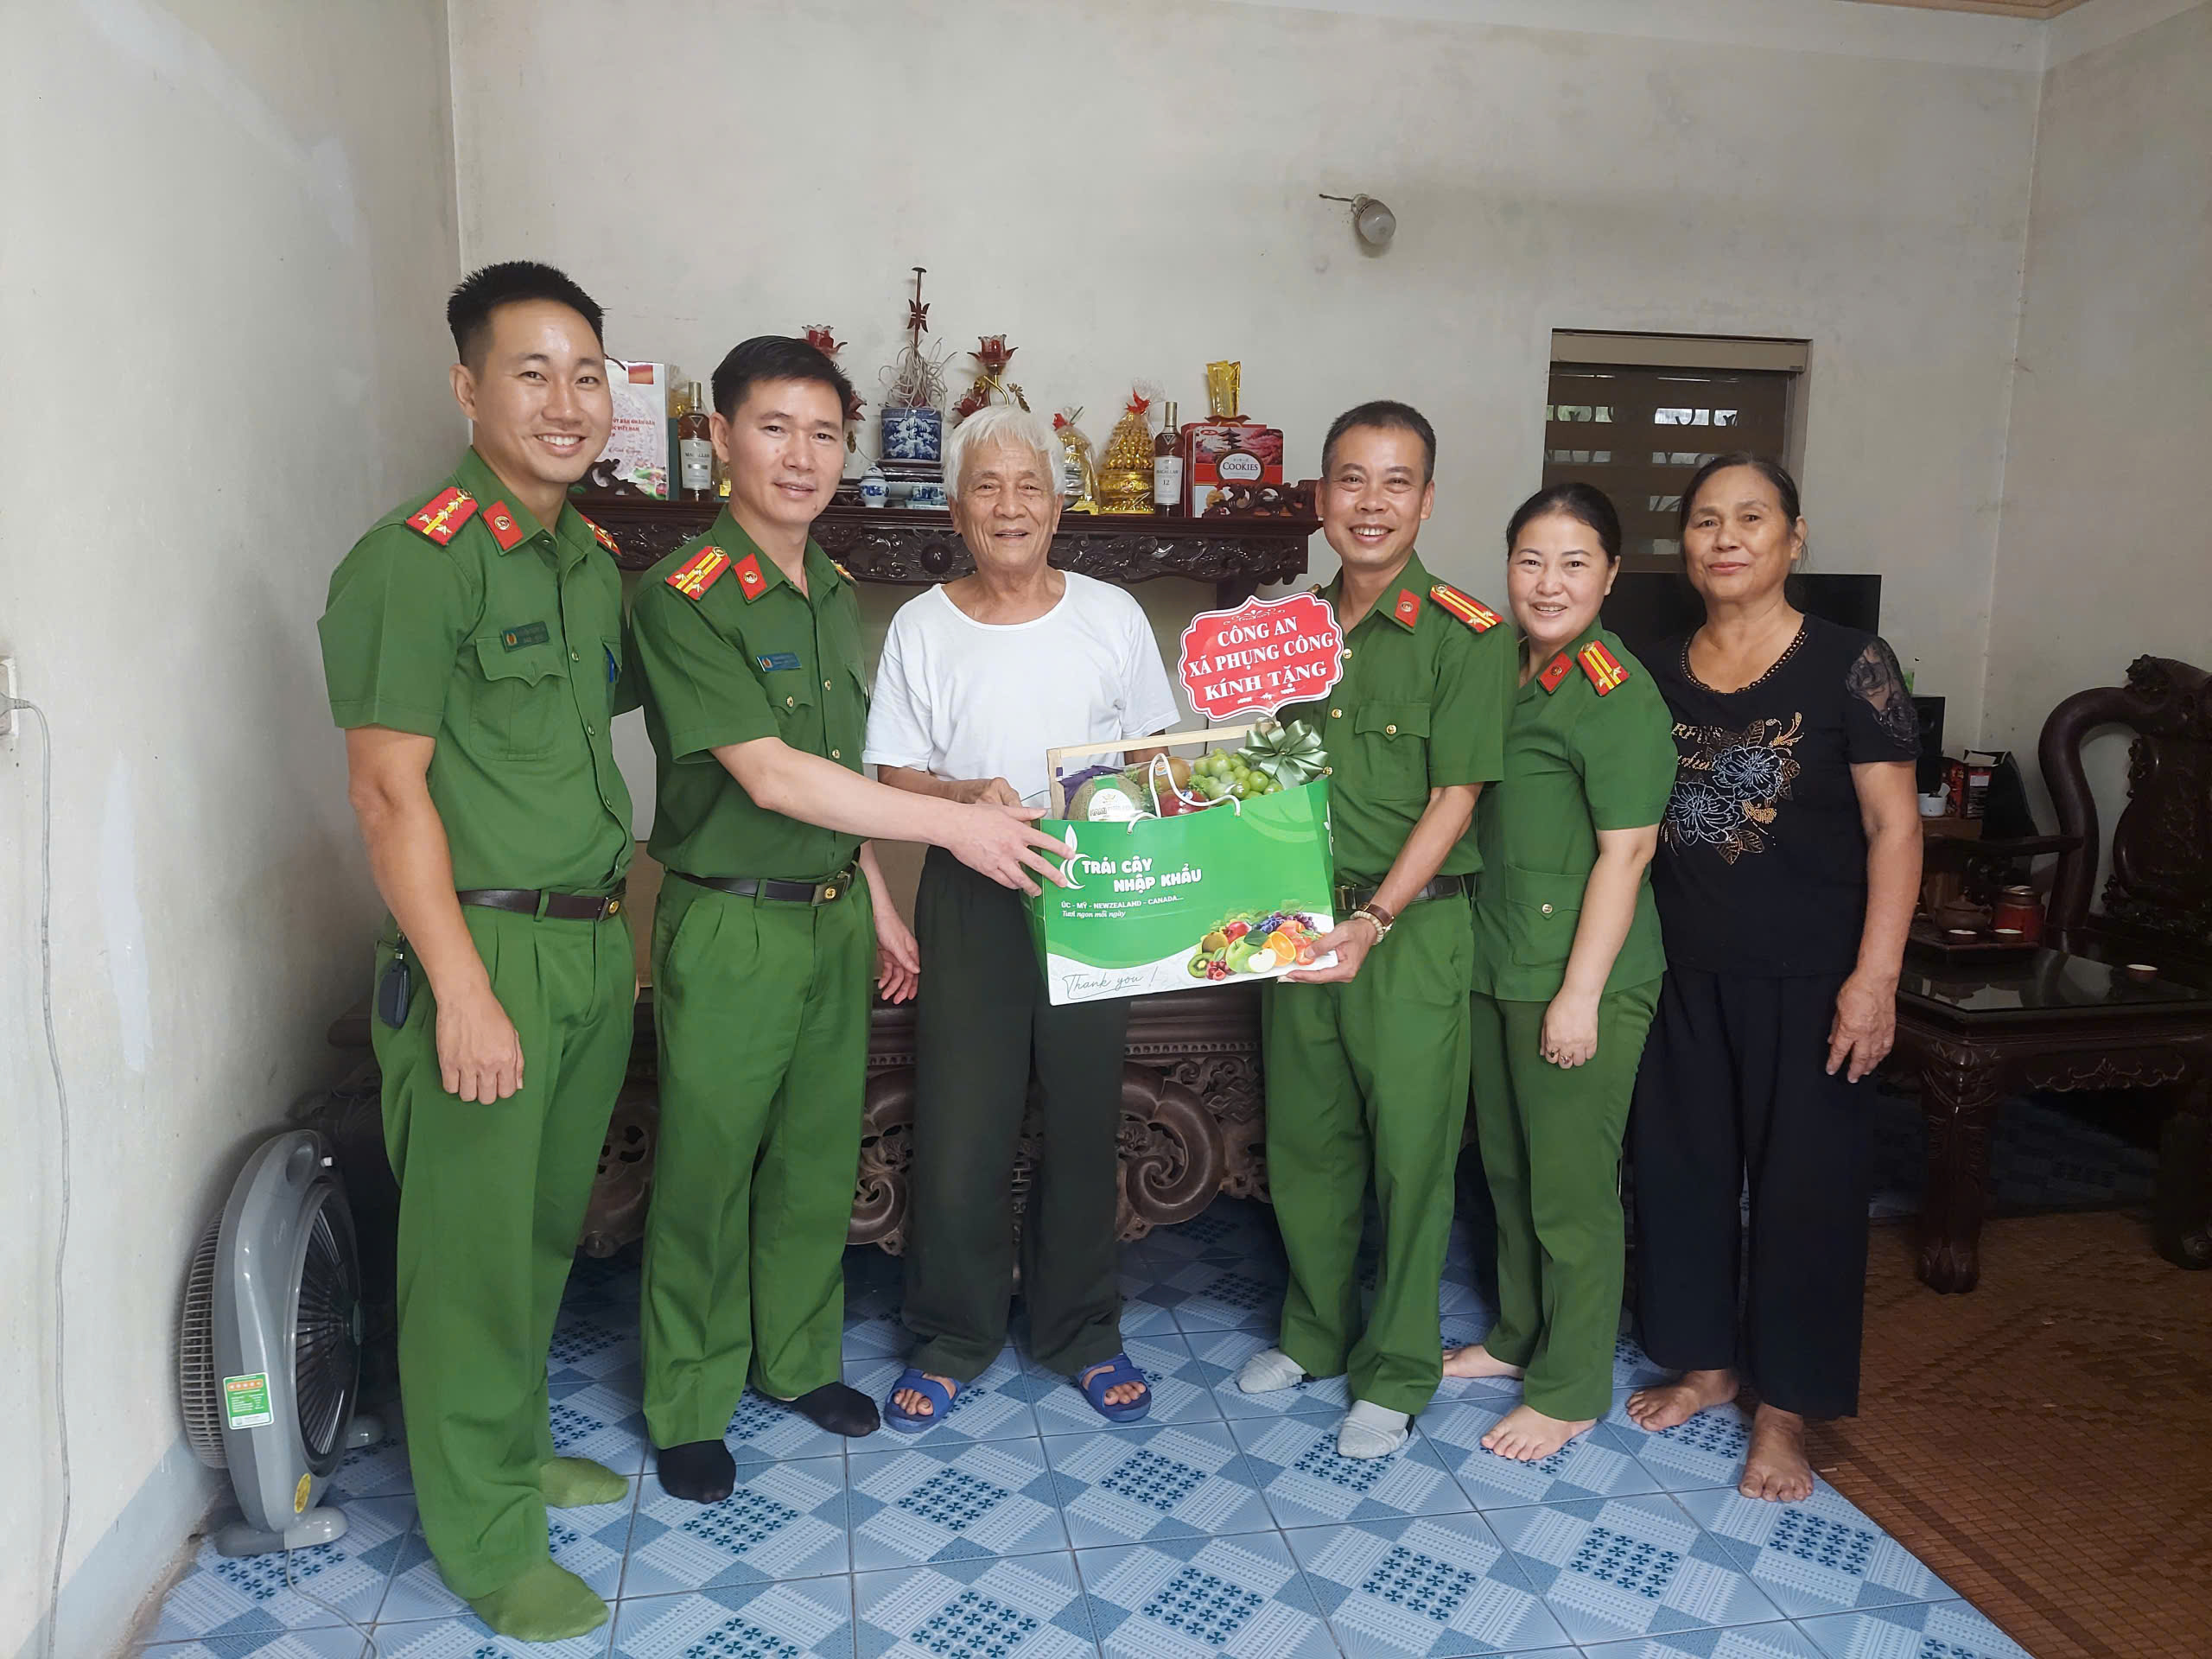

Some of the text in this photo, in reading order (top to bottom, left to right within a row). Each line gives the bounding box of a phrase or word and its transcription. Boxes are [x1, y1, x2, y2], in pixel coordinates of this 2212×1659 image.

[1217, 616, 1298, 647] CÔNG AN
[1187, 632, 1334, 678] XÃ PHỤNG CÔNG
[1204, 661, 1327, 702] KÍNH TẶNG
[1081, 855, 1153, 874] TRÁI CÂY
[1113, 862, 1202, 893] NHẬP KHẨU
[1093, 899, 1141, 909] NEWZEALAND
[1062, 972, 1111, 996] Thank
[1116, 976, 1144, 991] you
